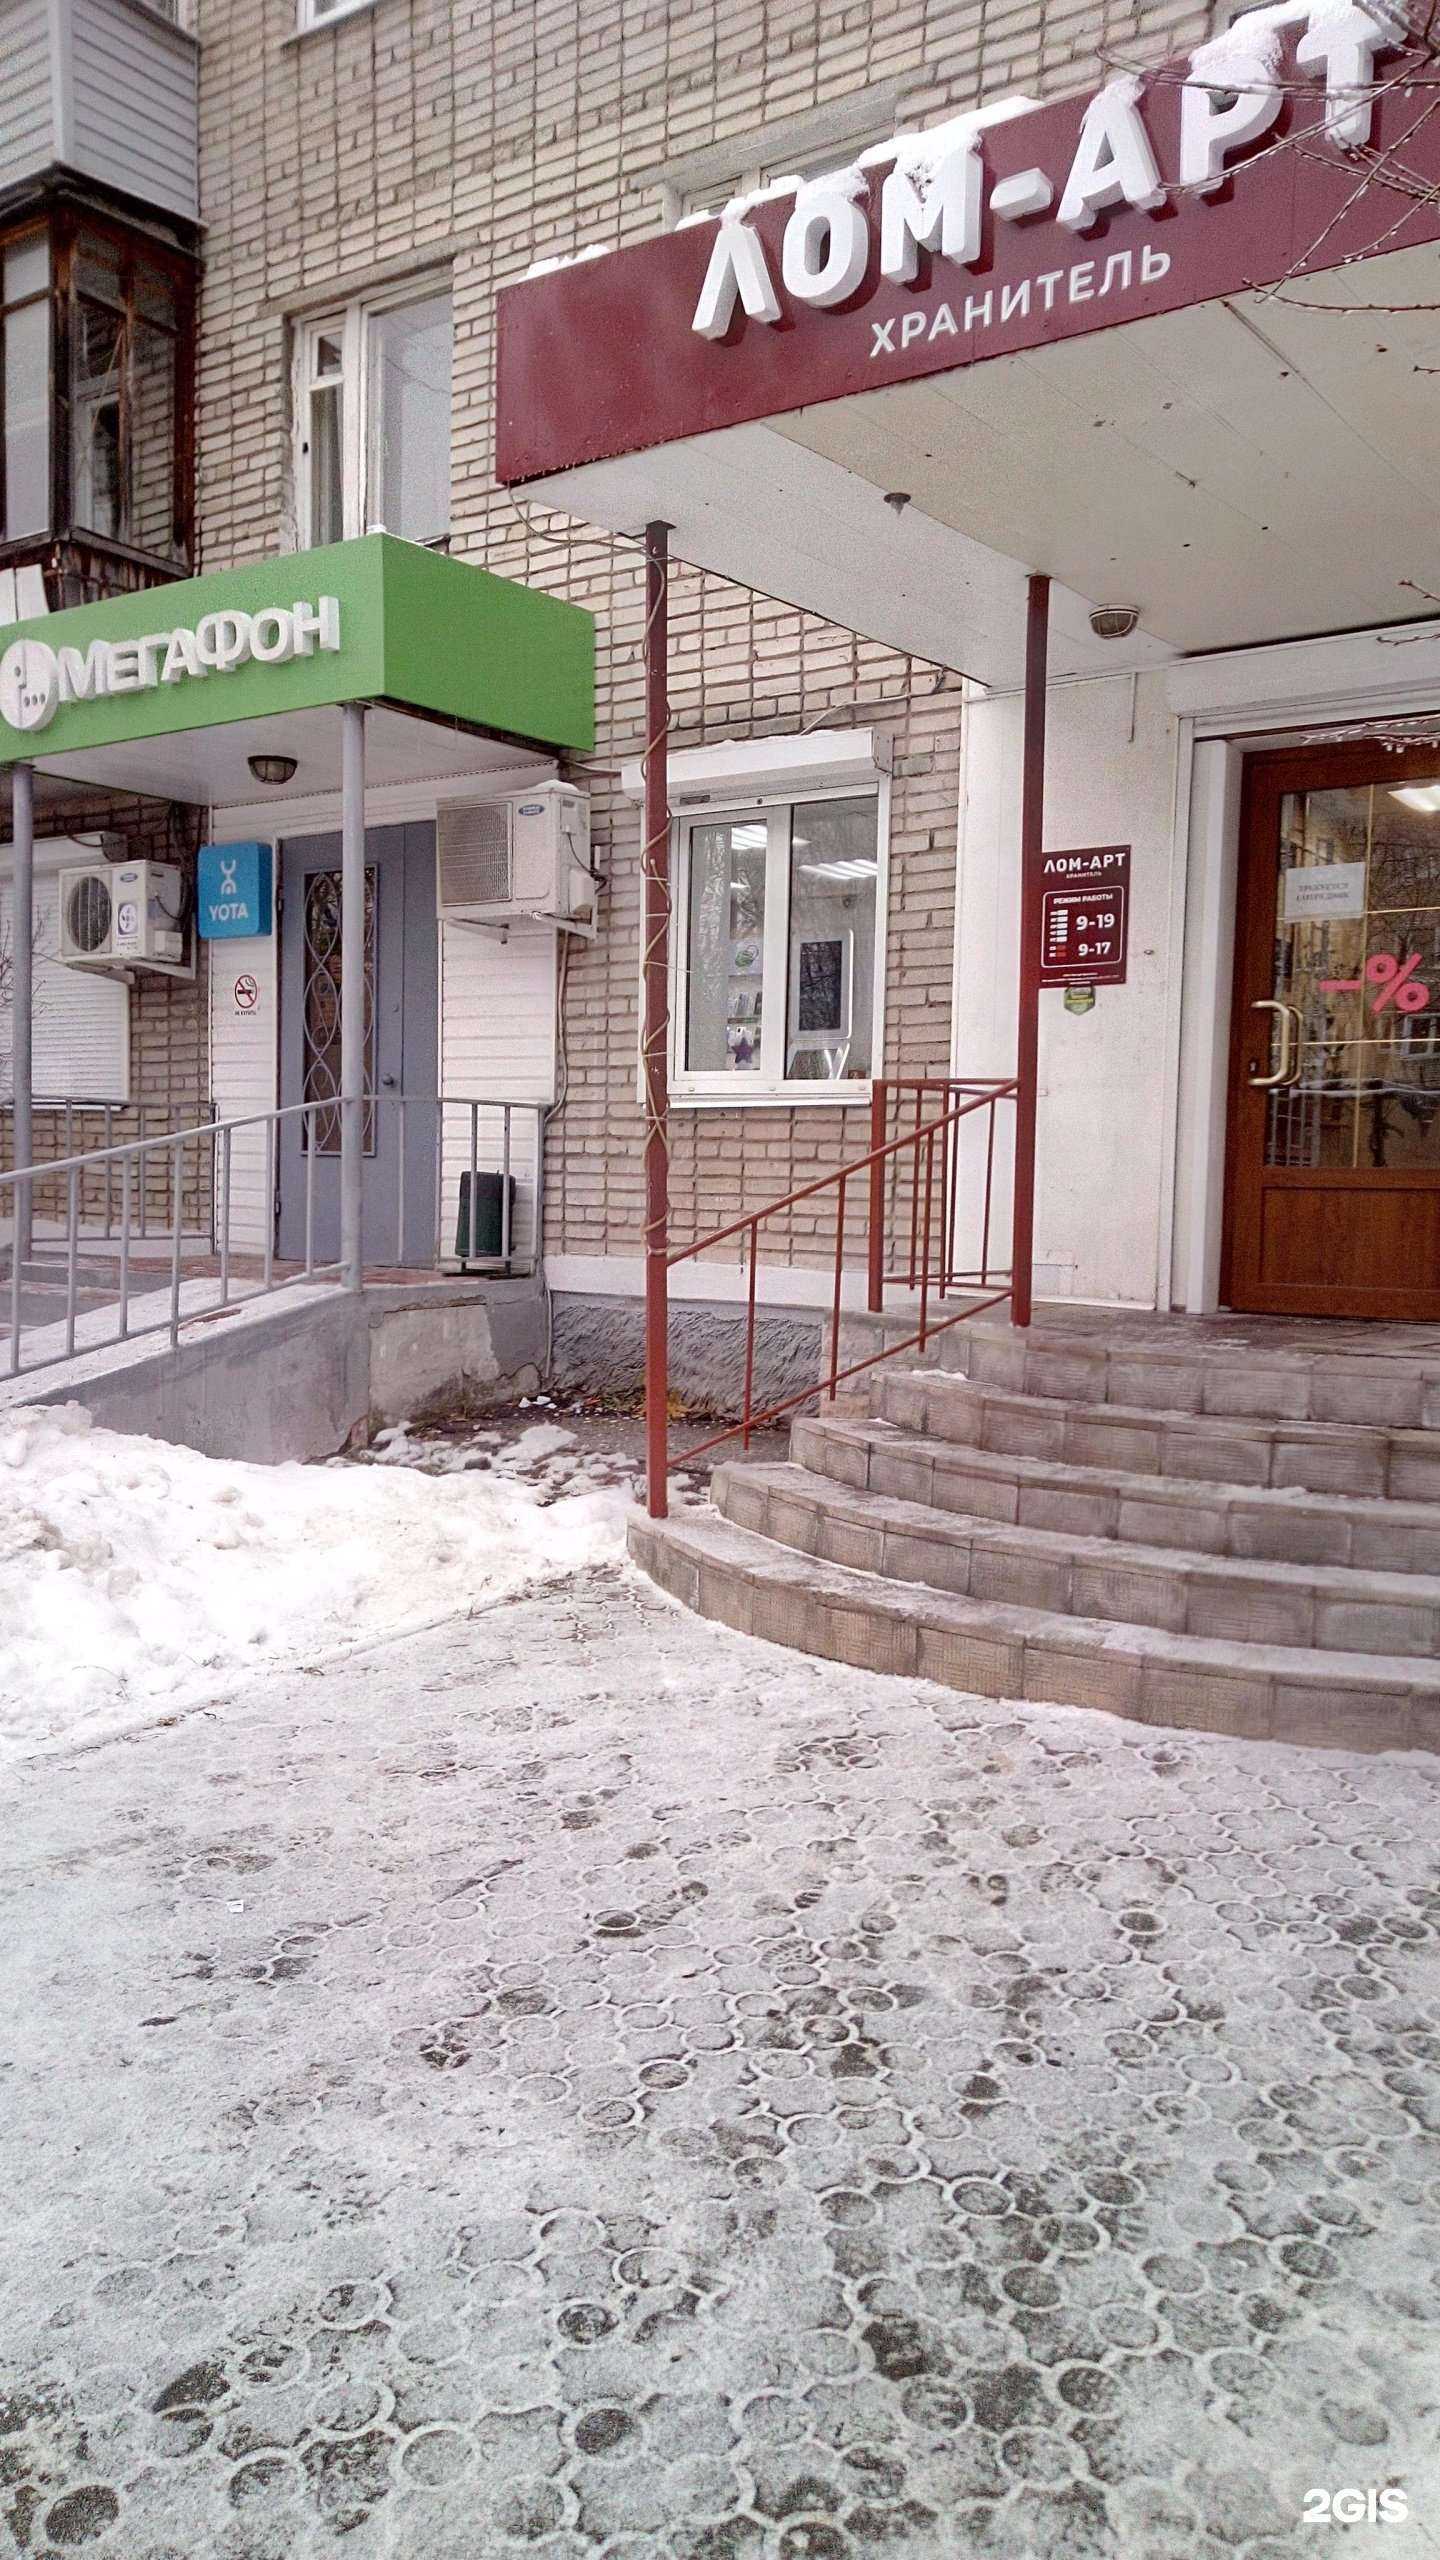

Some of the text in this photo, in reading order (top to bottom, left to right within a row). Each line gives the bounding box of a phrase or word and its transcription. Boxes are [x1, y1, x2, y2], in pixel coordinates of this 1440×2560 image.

[691, 8, 1397, 341] ЛОМ-АРТ
[869, 245, 1172, 359] ХРАНИТЕЛЬ
[57, 596, 341, 702] МЕГАФОН
[1044, 853, 1126, 873] ЛОМ-АРТ
[1082, 893, 1113, 902] РАБОТЫ
[208, 902, 249, 921] YOTA
[1076, 913, 1115, 931] 9-19
[1078, 942, 1111, 956] 9-17
